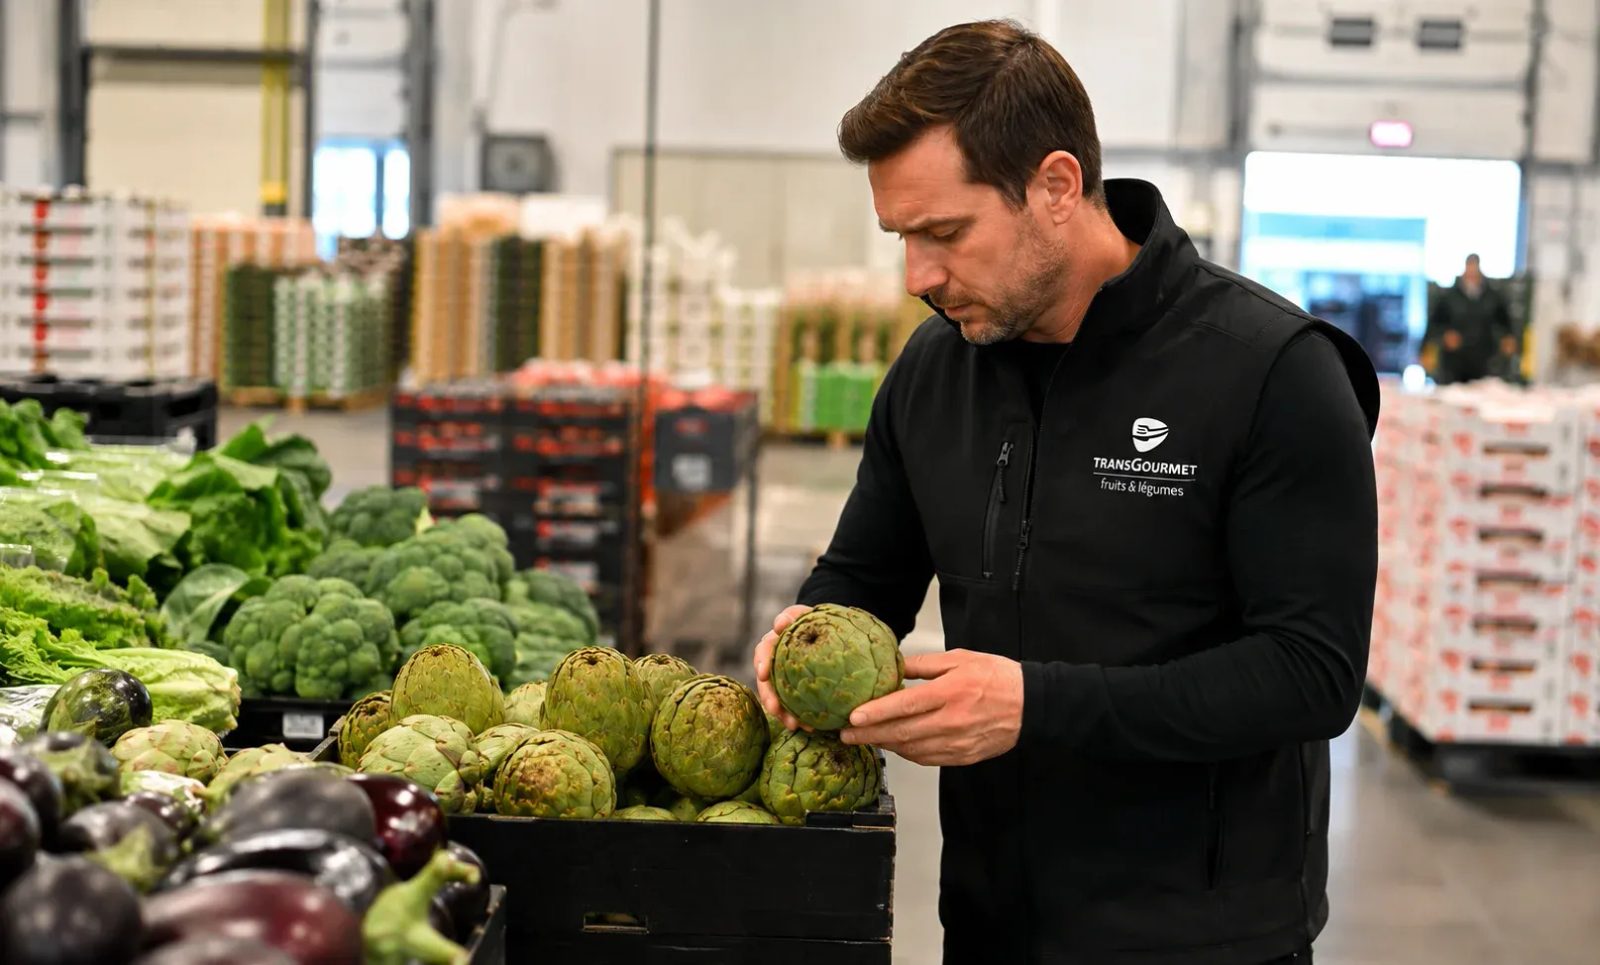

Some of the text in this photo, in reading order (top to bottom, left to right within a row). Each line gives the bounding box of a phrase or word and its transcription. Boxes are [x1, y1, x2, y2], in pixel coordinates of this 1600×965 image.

[1093, 457, 1198, 476] TRANSGOURMET
[1100, 477, 1184, 497] fruits & légumes
